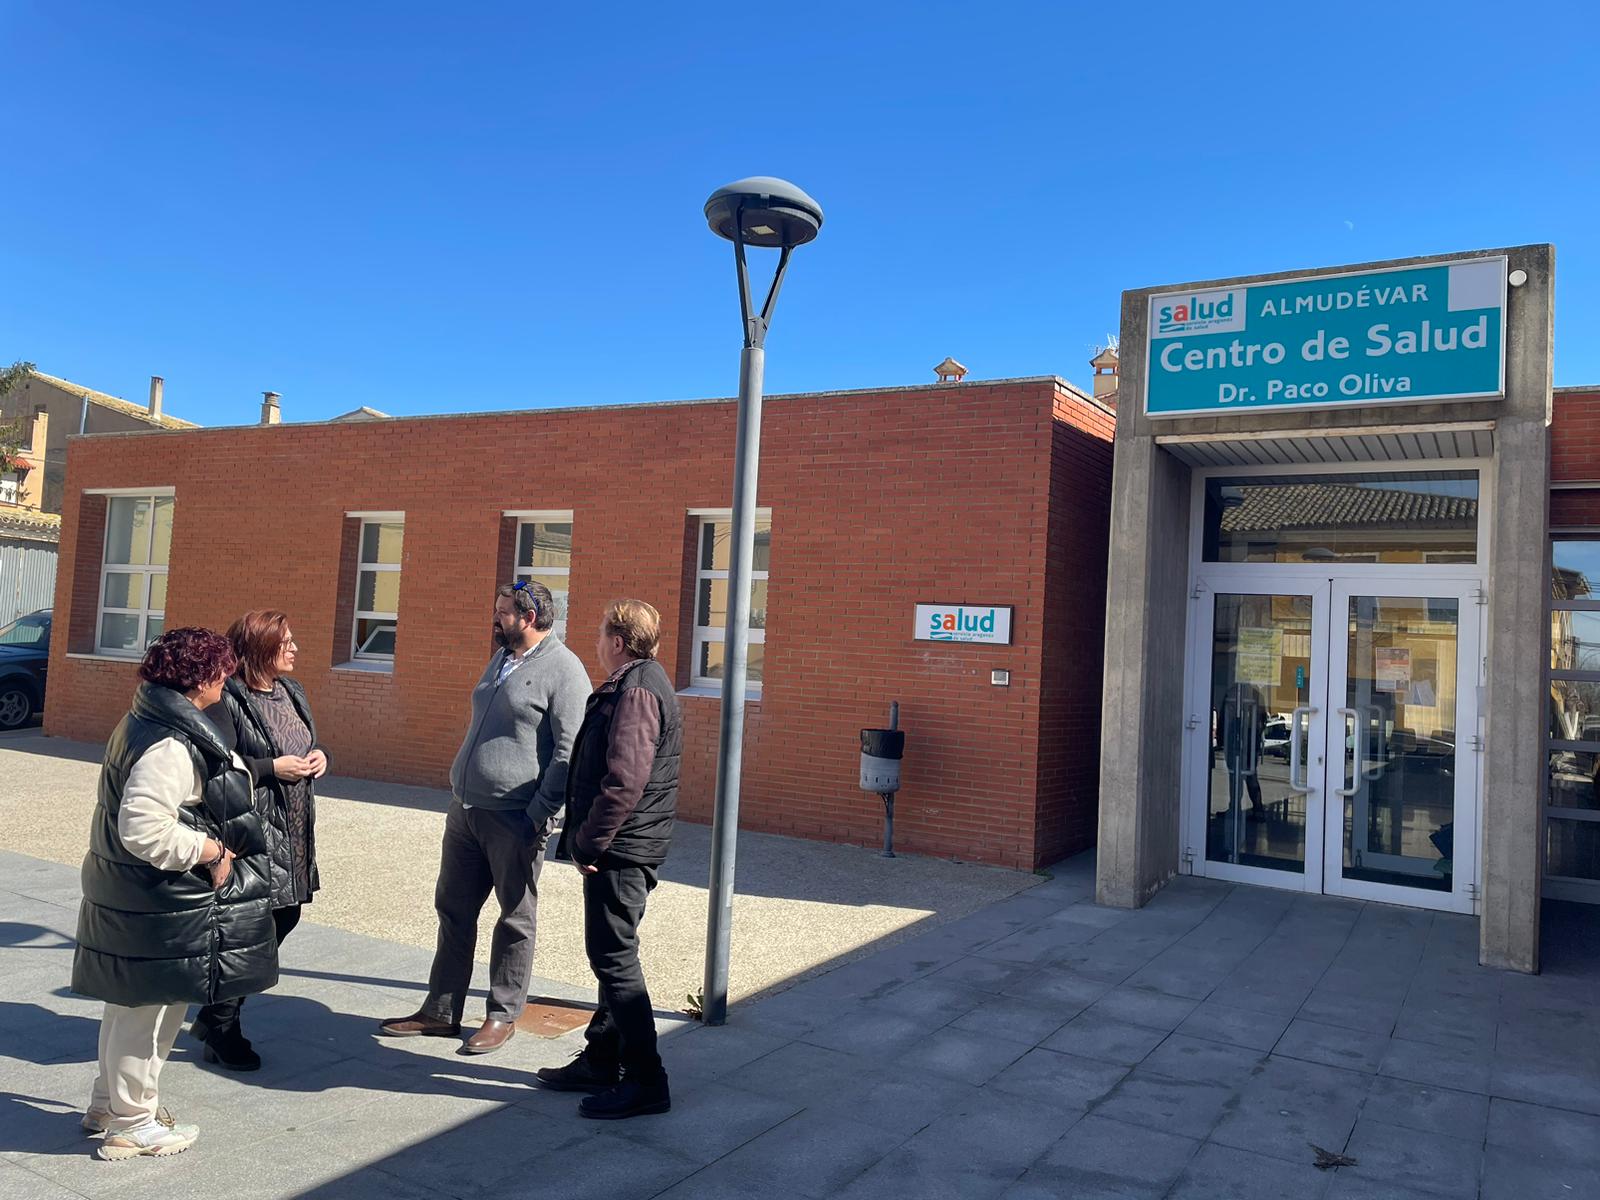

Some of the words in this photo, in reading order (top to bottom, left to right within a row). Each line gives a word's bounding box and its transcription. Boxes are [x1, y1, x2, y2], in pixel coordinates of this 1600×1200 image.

[1159, 293, 1233, 323] salud
[1261, 284, 1429, 317] ALMUDÉVAR
[1160, 339, 1286, 372] Centro
[1301, 330, 1350, 361] de
[1366, 315, 1487, 356] Salud
[1218, 383, 1256, 403] Dr.
[1267, 380, 1329, 400] Paco
[1339, 373, 1411, 395] Oliva
[930, 608, 995, 632] salud
